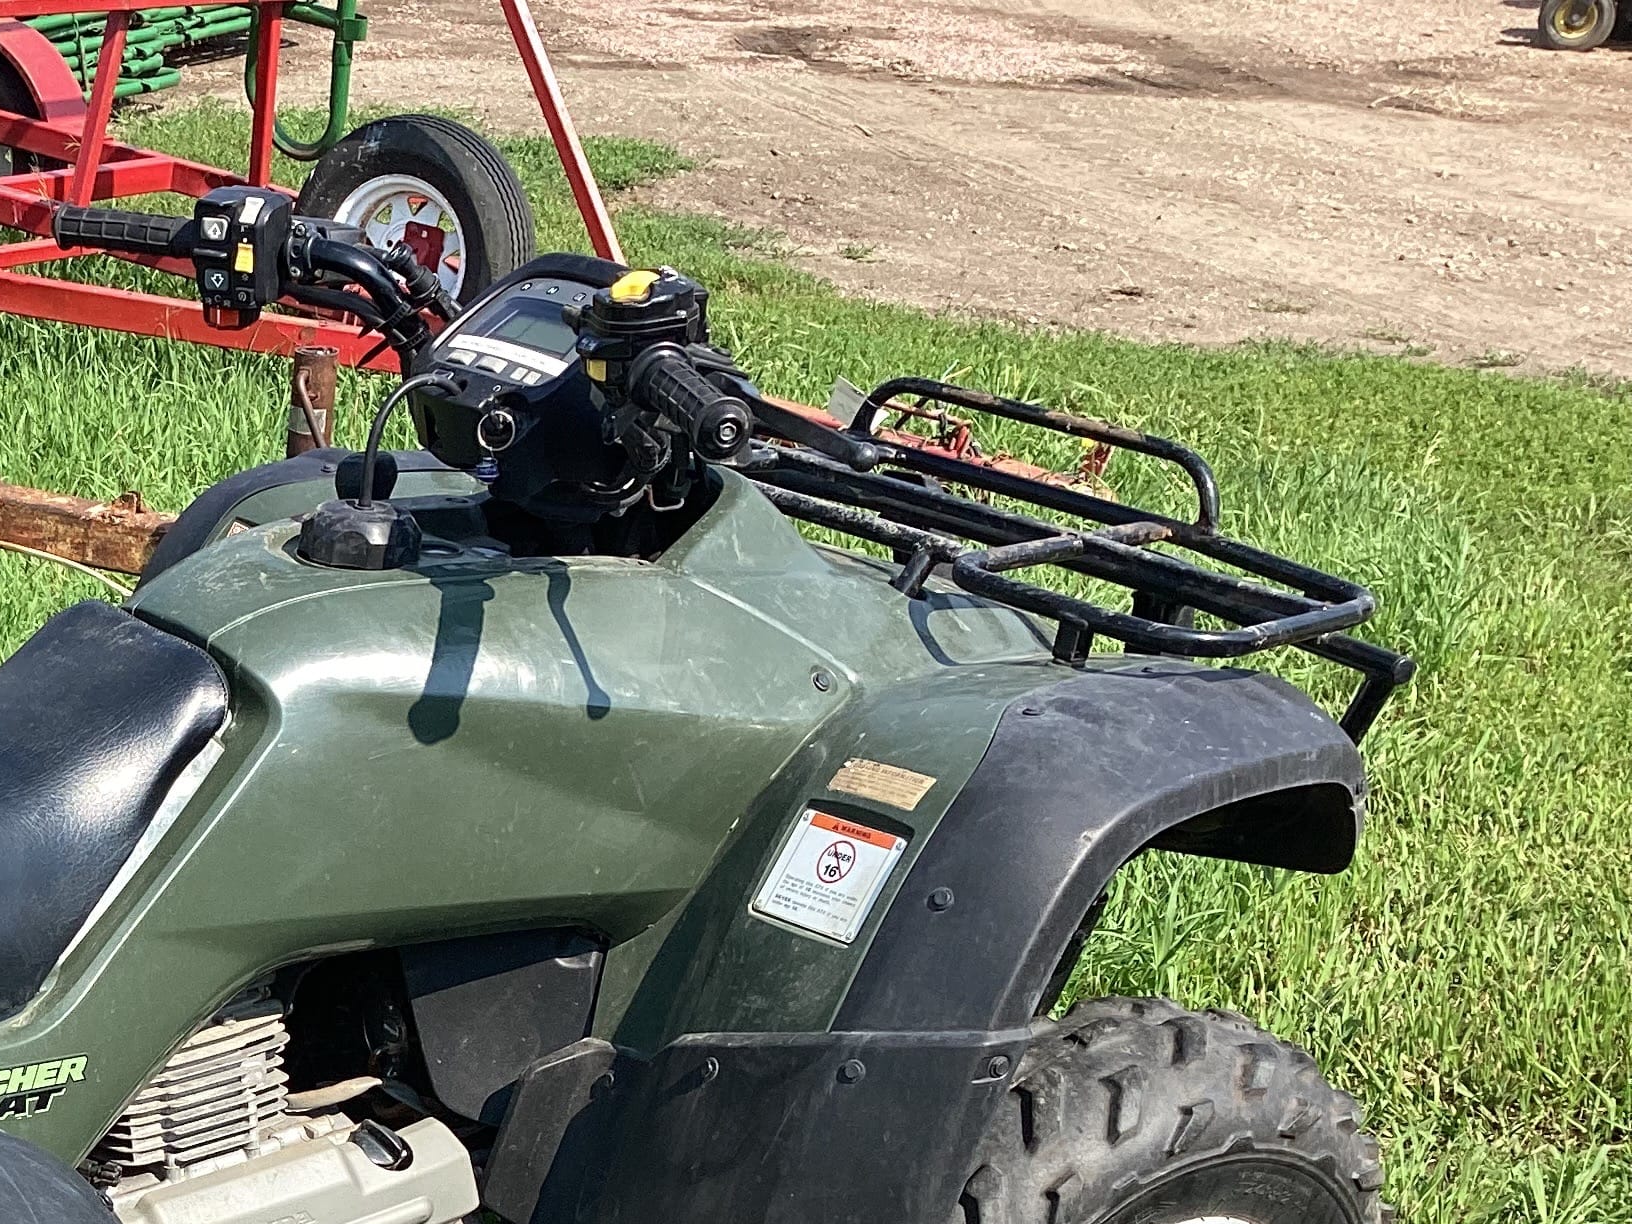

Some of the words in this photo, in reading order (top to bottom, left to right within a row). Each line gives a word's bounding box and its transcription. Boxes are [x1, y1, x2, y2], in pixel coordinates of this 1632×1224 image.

[840, 824, 872, 839] WARNING
[827, 849, 852, 863] UNDER
[823, 863, 839, 878] 16
